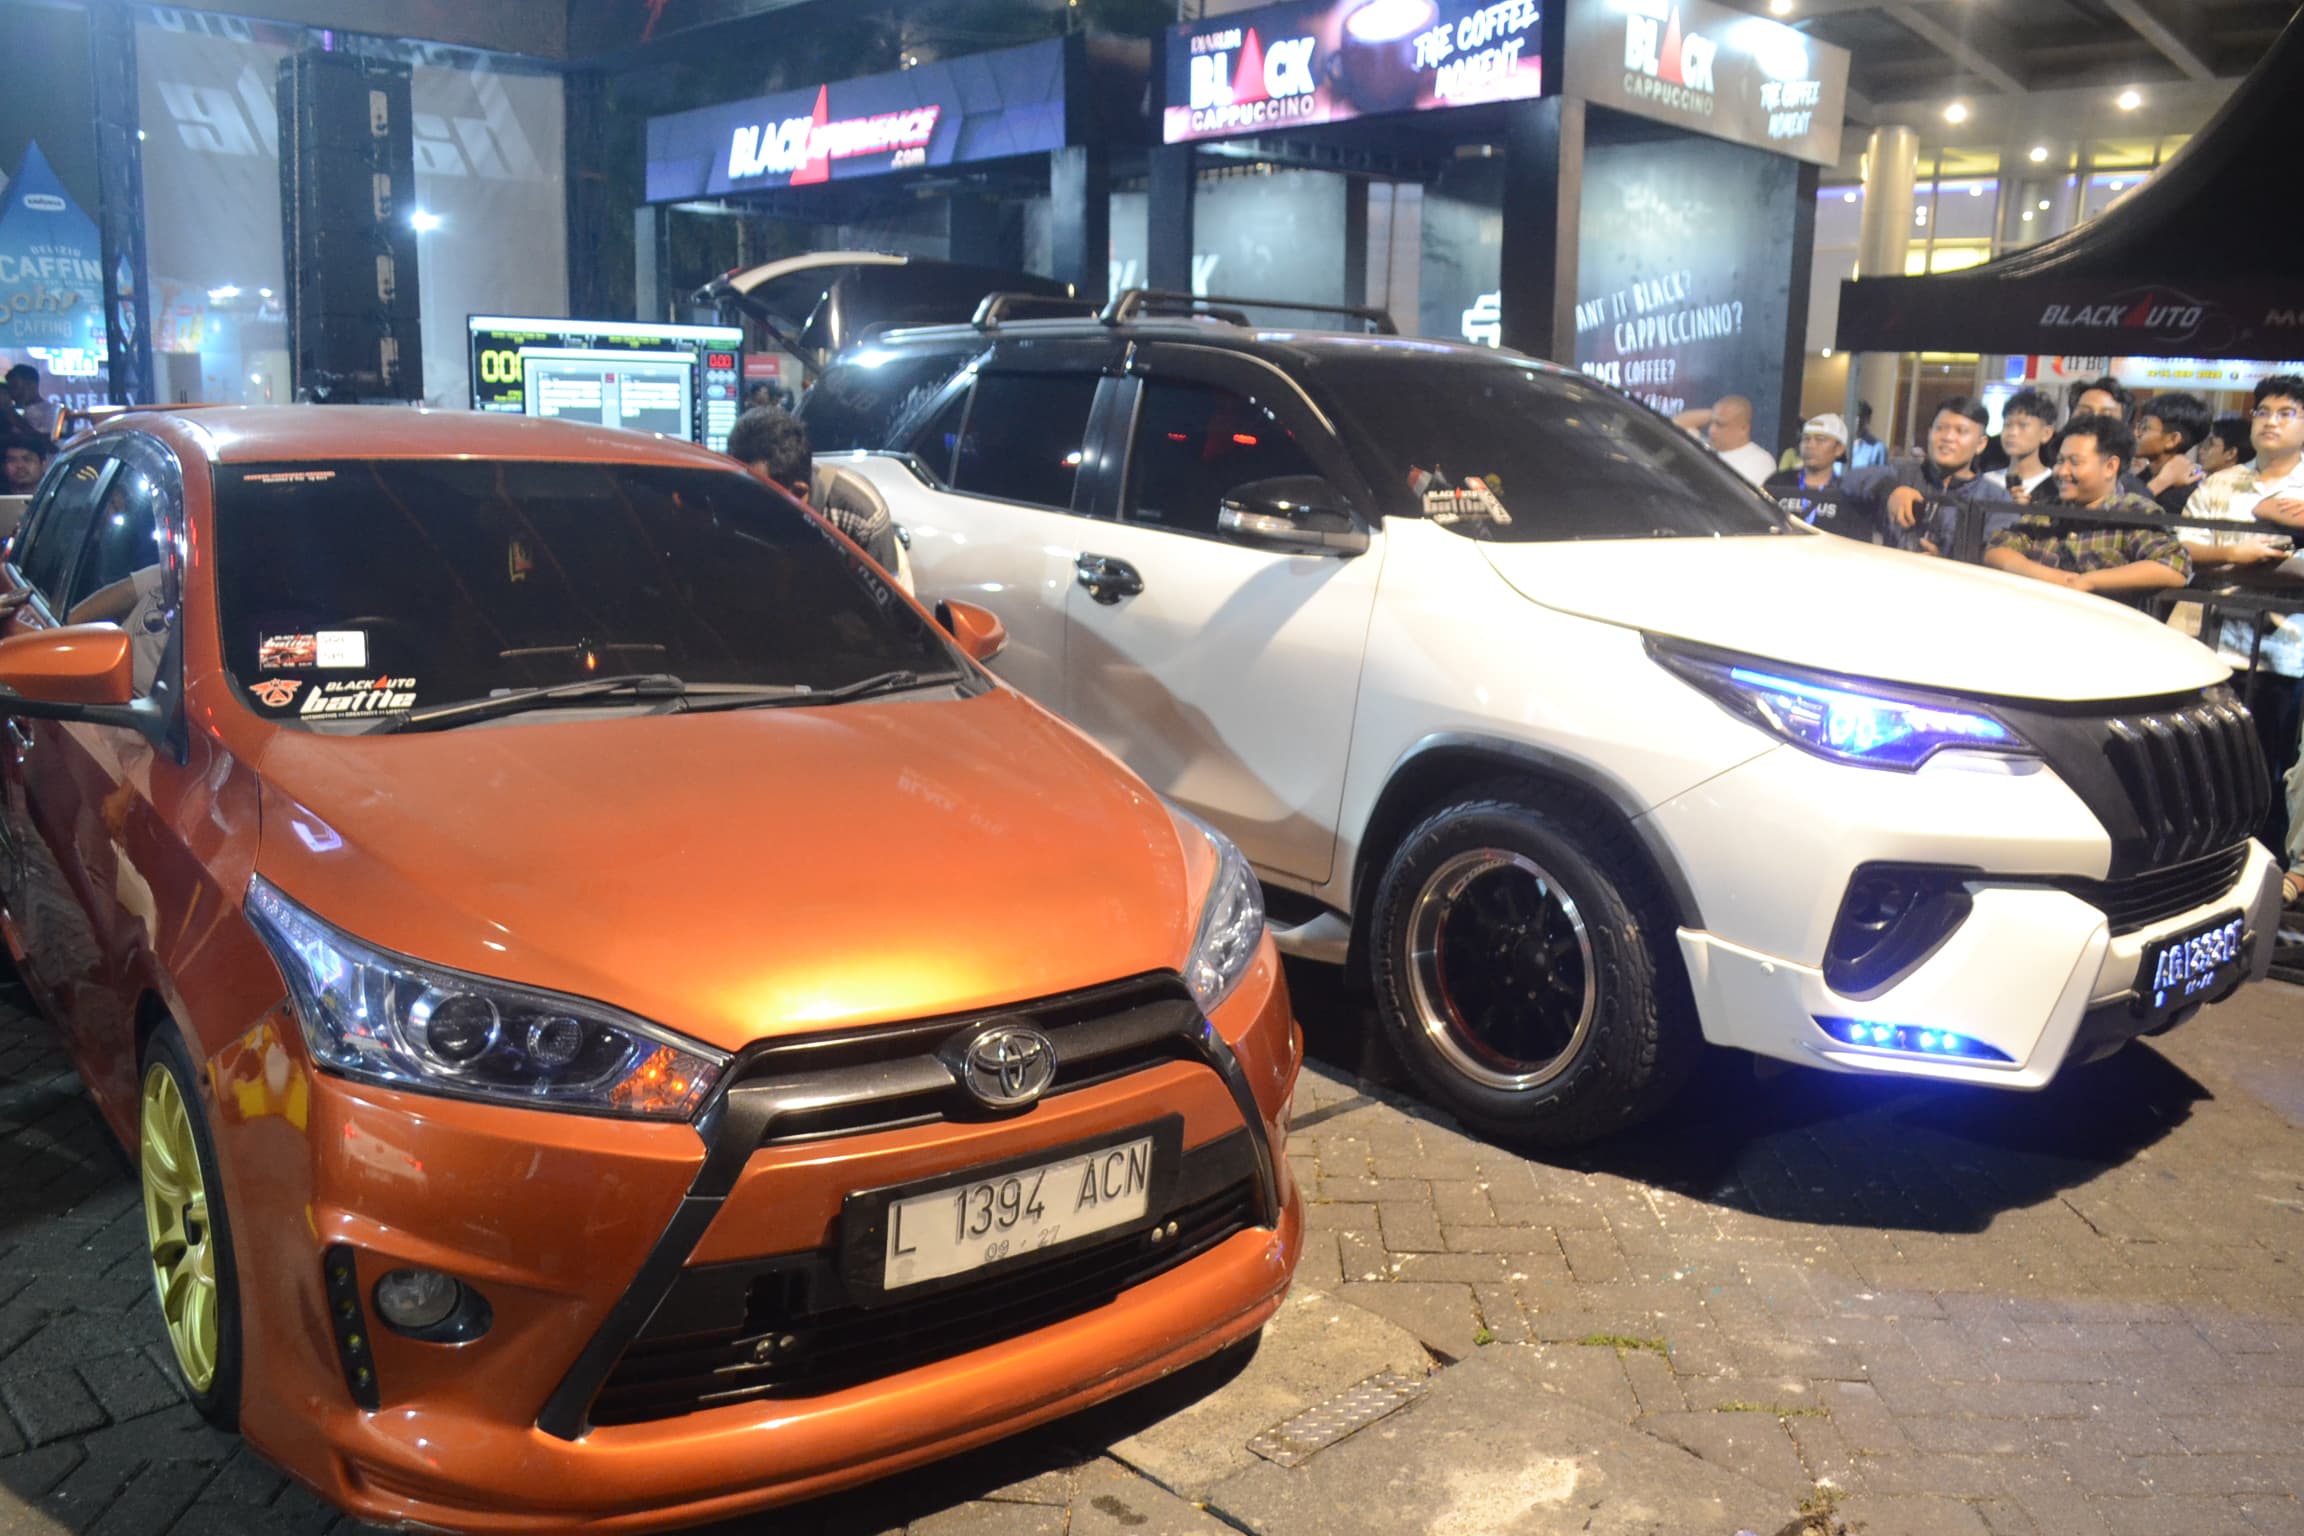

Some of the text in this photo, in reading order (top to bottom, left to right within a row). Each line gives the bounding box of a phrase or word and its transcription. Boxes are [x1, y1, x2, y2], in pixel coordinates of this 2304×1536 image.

[1413, 0, 1540, 68] THE COFFEE
[1624, 4, 1717, 94] BLACK
[1190, 27, 1316, 110] BLACK
[1624, 73, 1714, 117] CAPPUCCINO
[1192, 94, 1316, 131] CAPPUCCINO
[1612, 290, 1627, 320] IT
[1632, 269, 1691, 314] BLACK?
[1614, 300, 1743, 355] CAPPUCCINNO?
[1624, 358, 1677, 386] COFFEE?
[300, 685, 417, 714] battle
[893, 1142, 1149, 1257] L 1394 ACN
